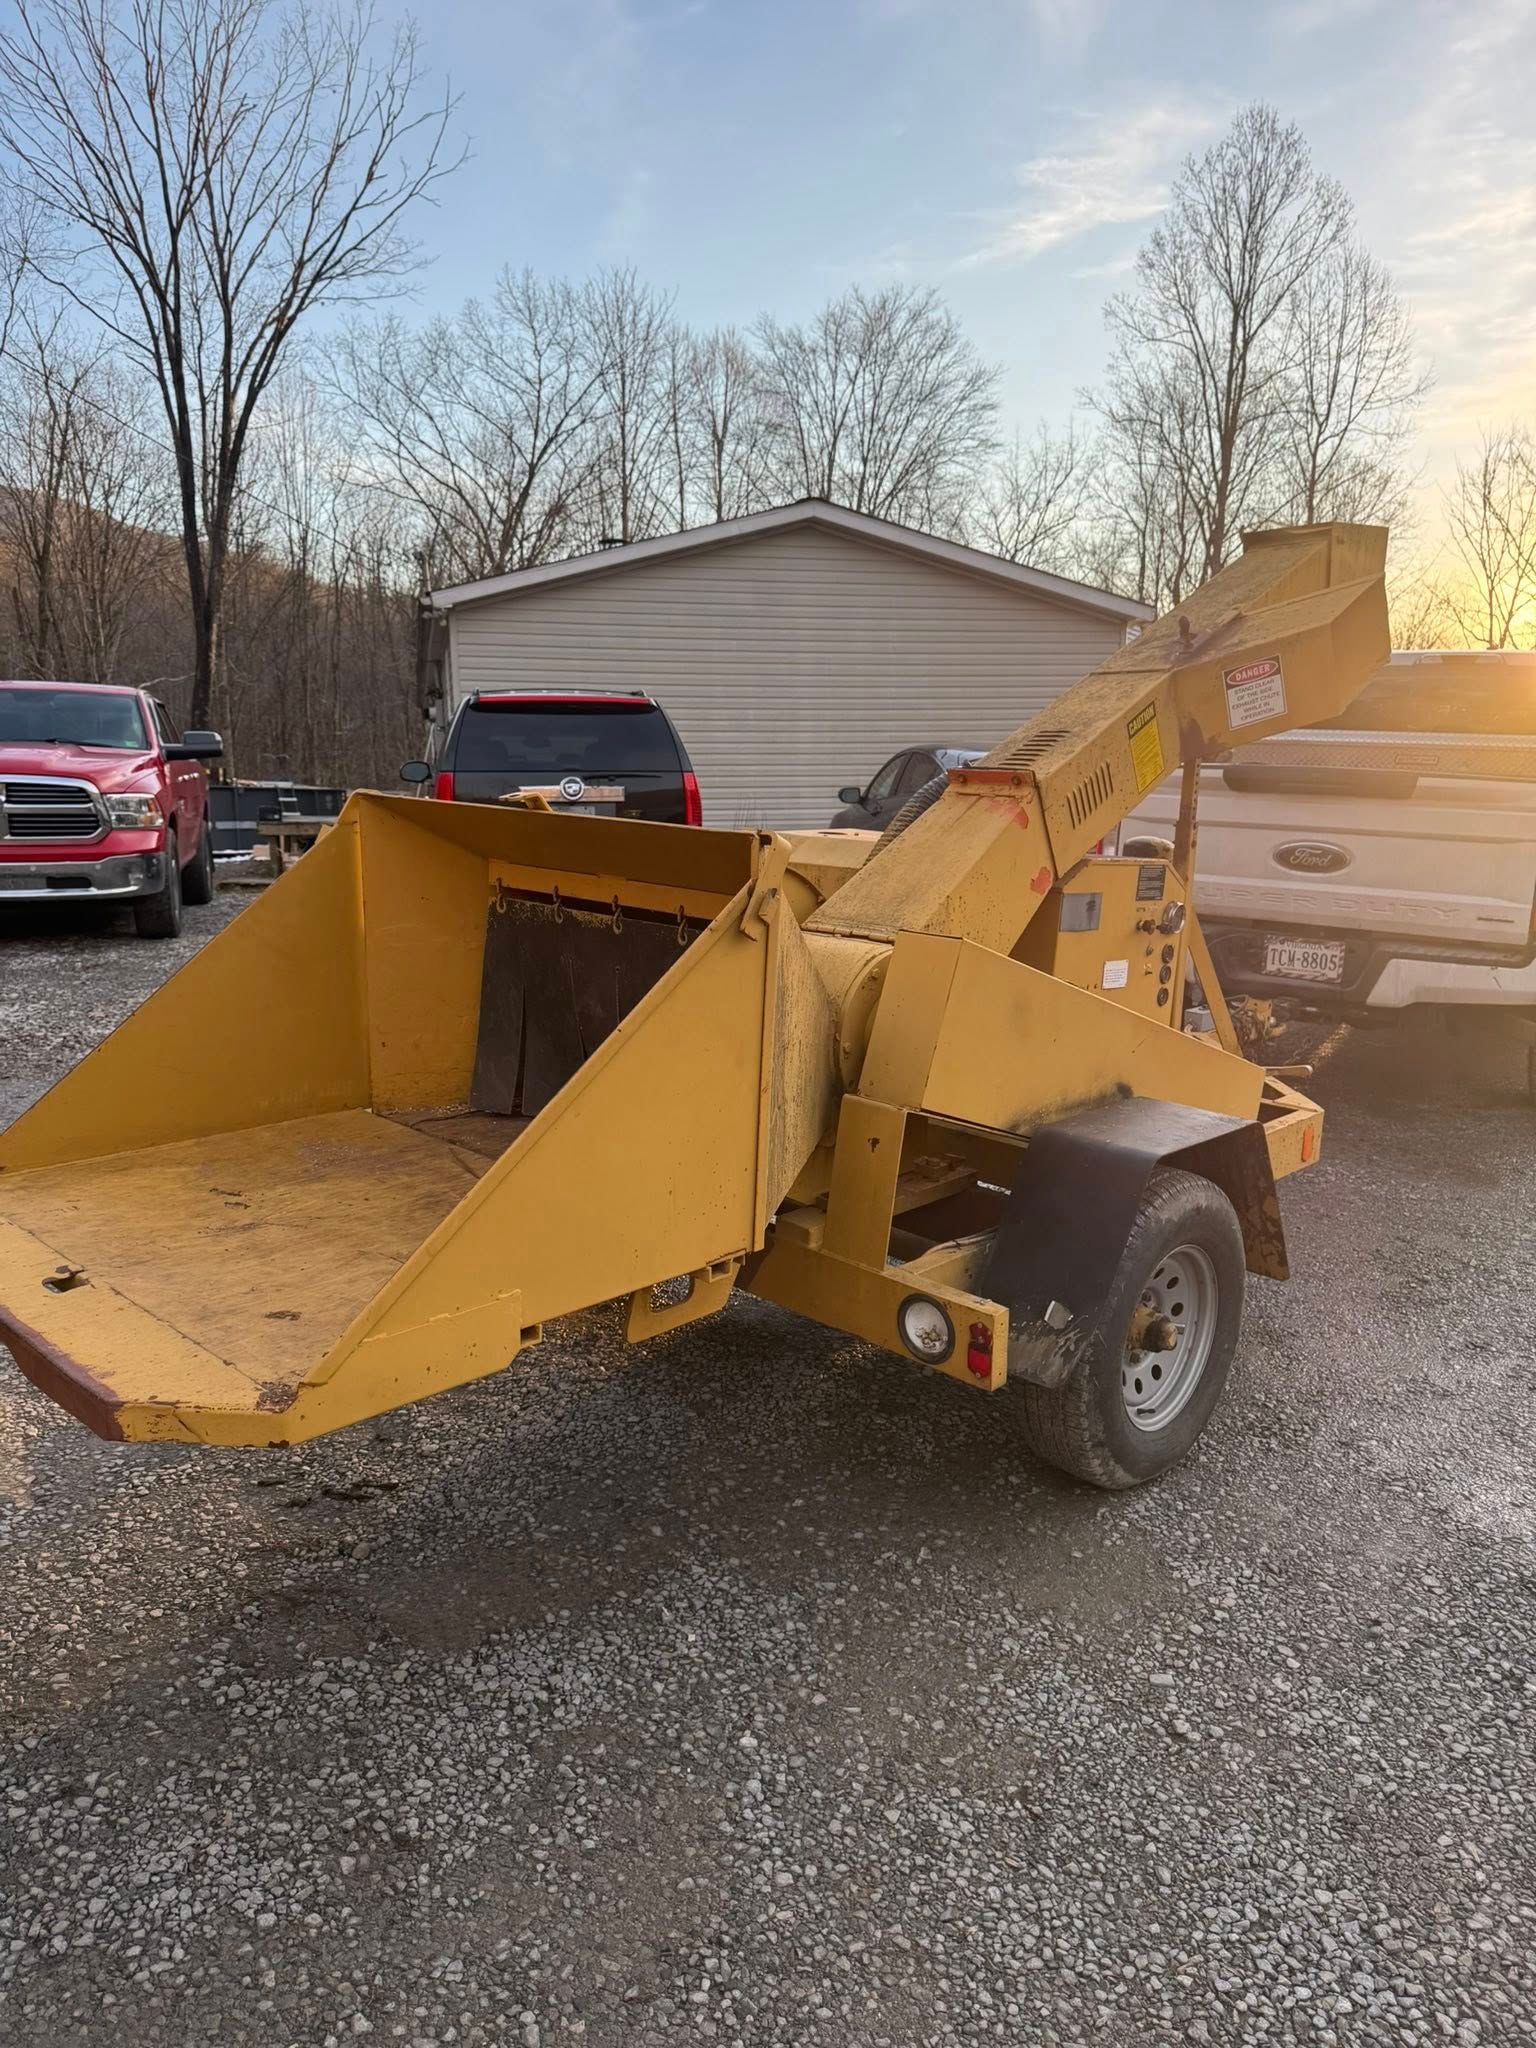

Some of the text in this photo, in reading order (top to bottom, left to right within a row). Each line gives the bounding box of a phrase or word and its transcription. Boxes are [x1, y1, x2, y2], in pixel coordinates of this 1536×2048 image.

[1235, 663, 1271, 681] DANGER
[1234, 684, 1255, 696] STAND
[1247, 690, 1257, 699] THE
[1232, 698, 1259, 710] EXHAUST
[1129, 704, 1156, 733] CAUTION
[1240, 707, 1275, 721] OPERATION
[1289, 847, 1332, 867] Ford
[1196, 886, 1461, 919] UPER DUTY
[1285, 940, 1323, 951] VIRGINIA
[1270, 947, 1338, 972] TCM-8805
